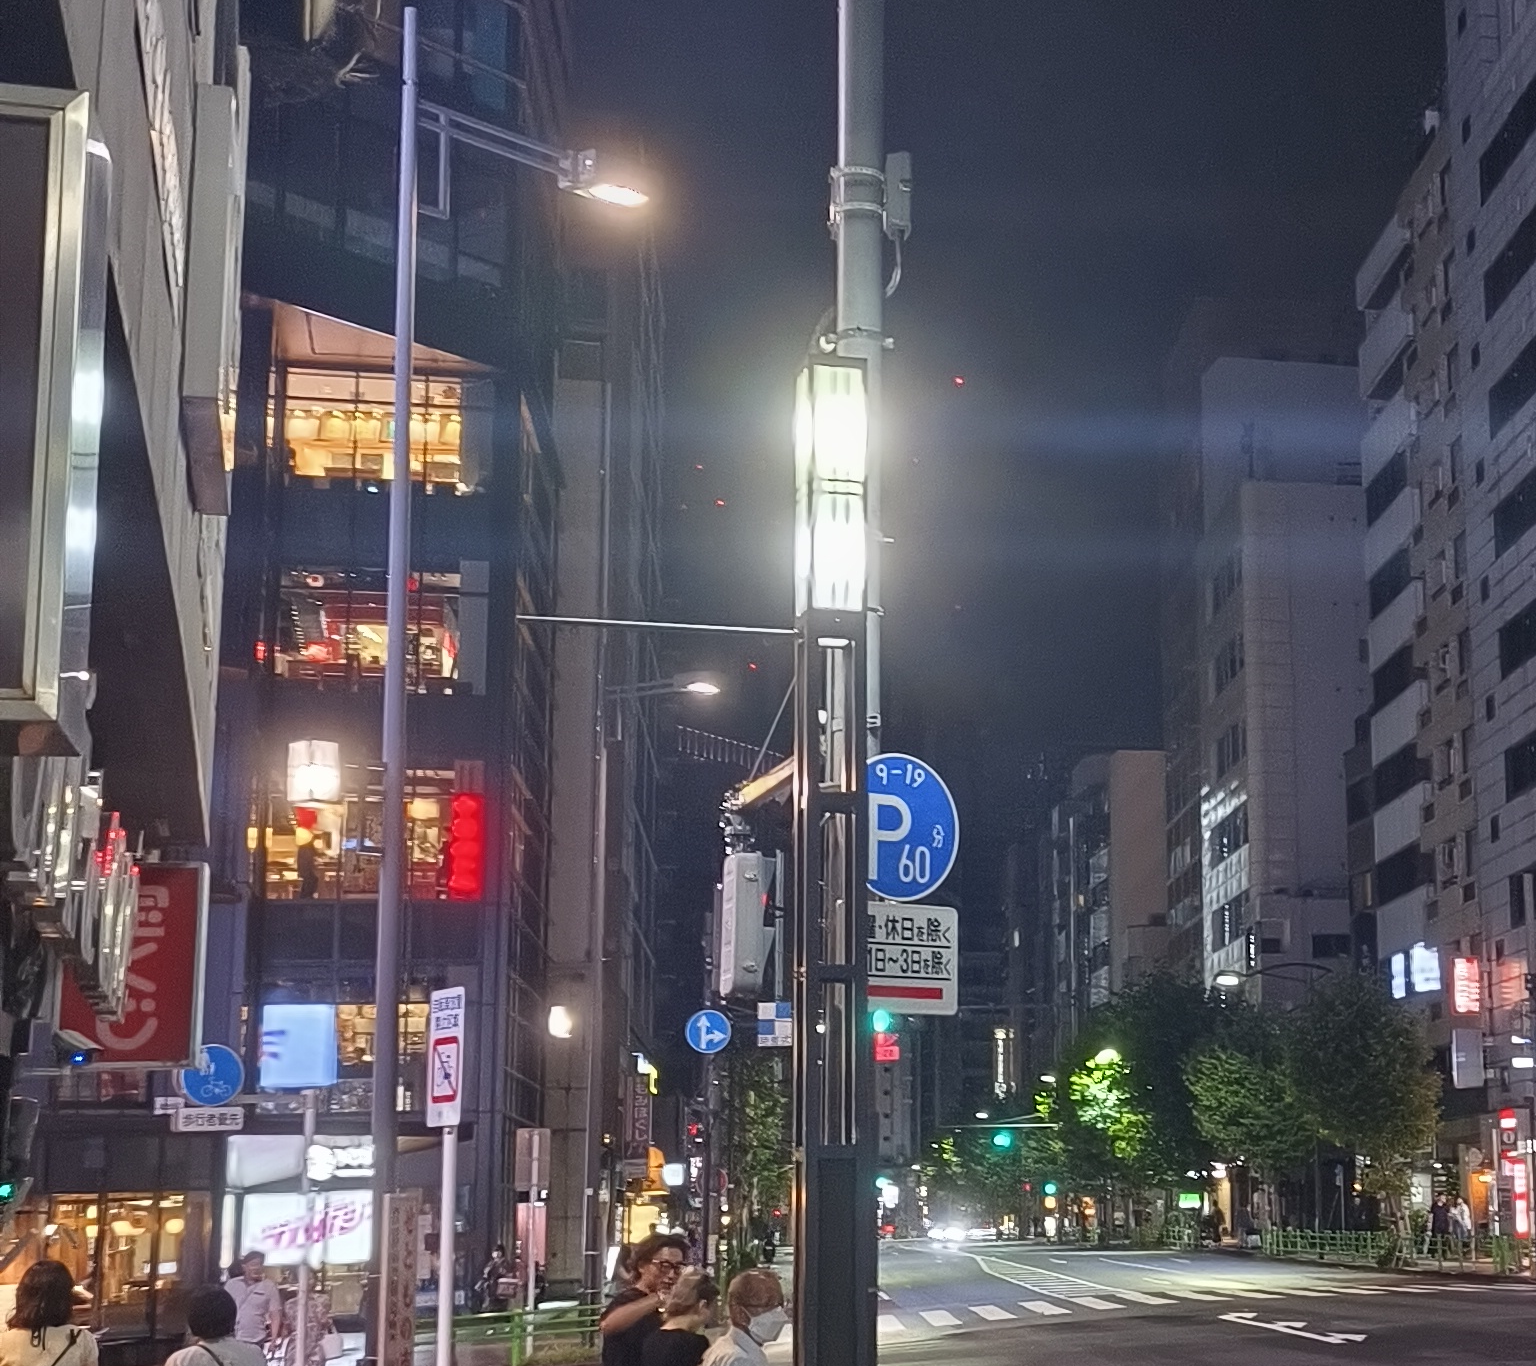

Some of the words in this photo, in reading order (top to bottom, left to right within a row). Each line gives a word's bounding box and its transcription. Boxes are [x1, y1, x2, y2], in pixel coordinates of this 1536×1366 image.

[875, 763, 926, 788] 9-19
[868, 792, 912, 880] P
[899, 844, 931, 883] 60
